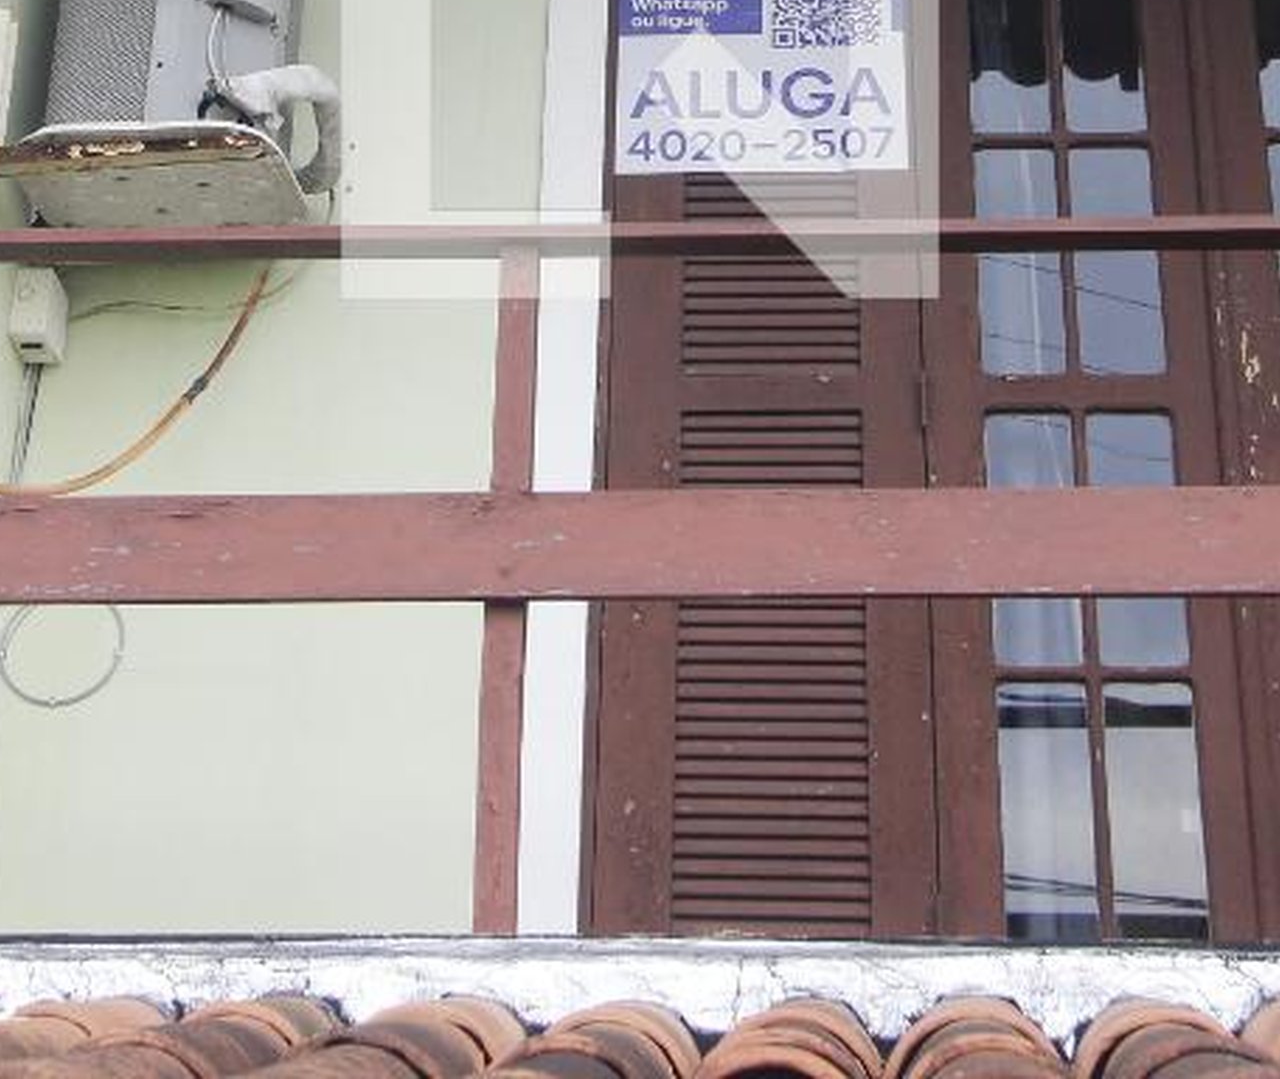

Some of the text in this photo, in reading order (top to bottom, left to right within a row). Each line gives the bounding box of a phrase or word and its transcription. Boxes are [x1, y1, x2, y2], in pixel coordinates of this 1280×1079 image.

[631, 17, 654, 27] ou
[630, 68, 892, 119] ALUGA
[627, 129, 895, 162] 4020-2507
